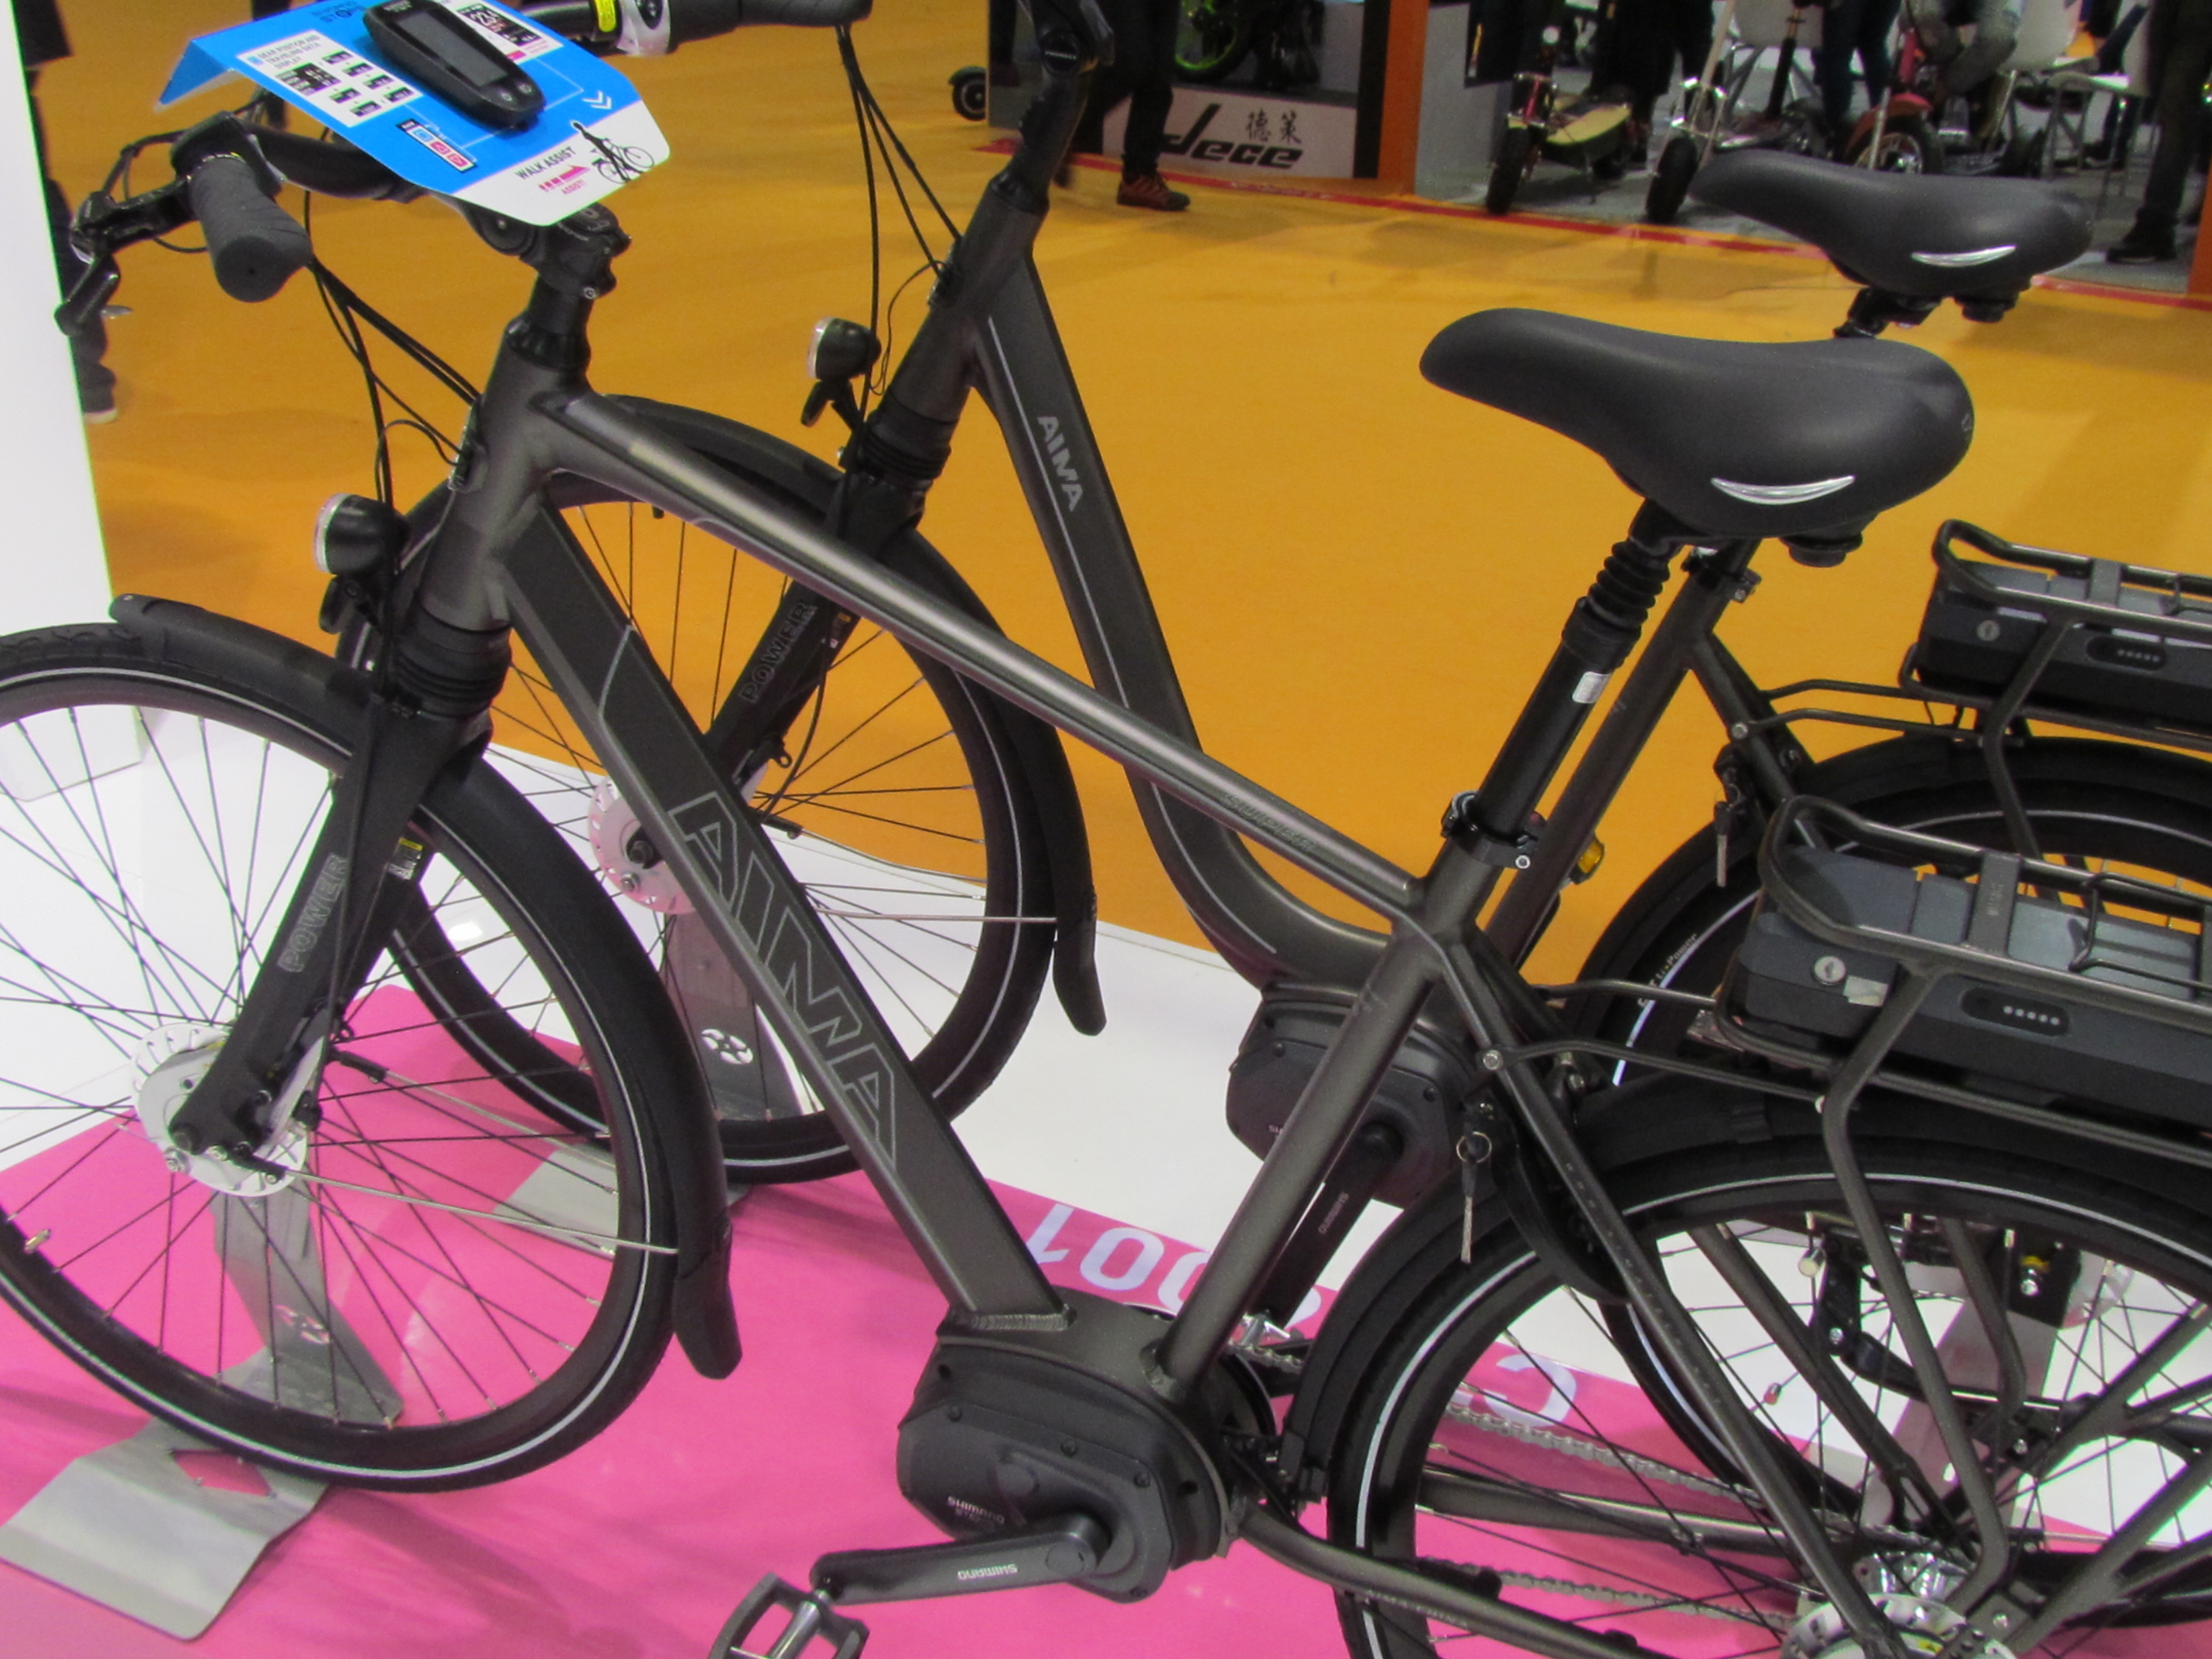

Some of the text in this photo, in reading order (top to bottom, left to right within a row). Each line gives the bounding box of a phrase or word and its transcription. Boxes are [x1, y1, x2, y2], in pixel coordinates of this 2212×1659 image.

[514, 146, 577, 180] WALK ASSIST
[1037, 416, 1083, 512] AIMA
[739, 602, 818, 705] POWER
[276, 852, 350, 973] POWER
[668, 790, 897, 1167] AIMA
[947, 1495, 1005, 1524] SHIMANO
[956, 1563, 1018, 1581] SHIMANO
